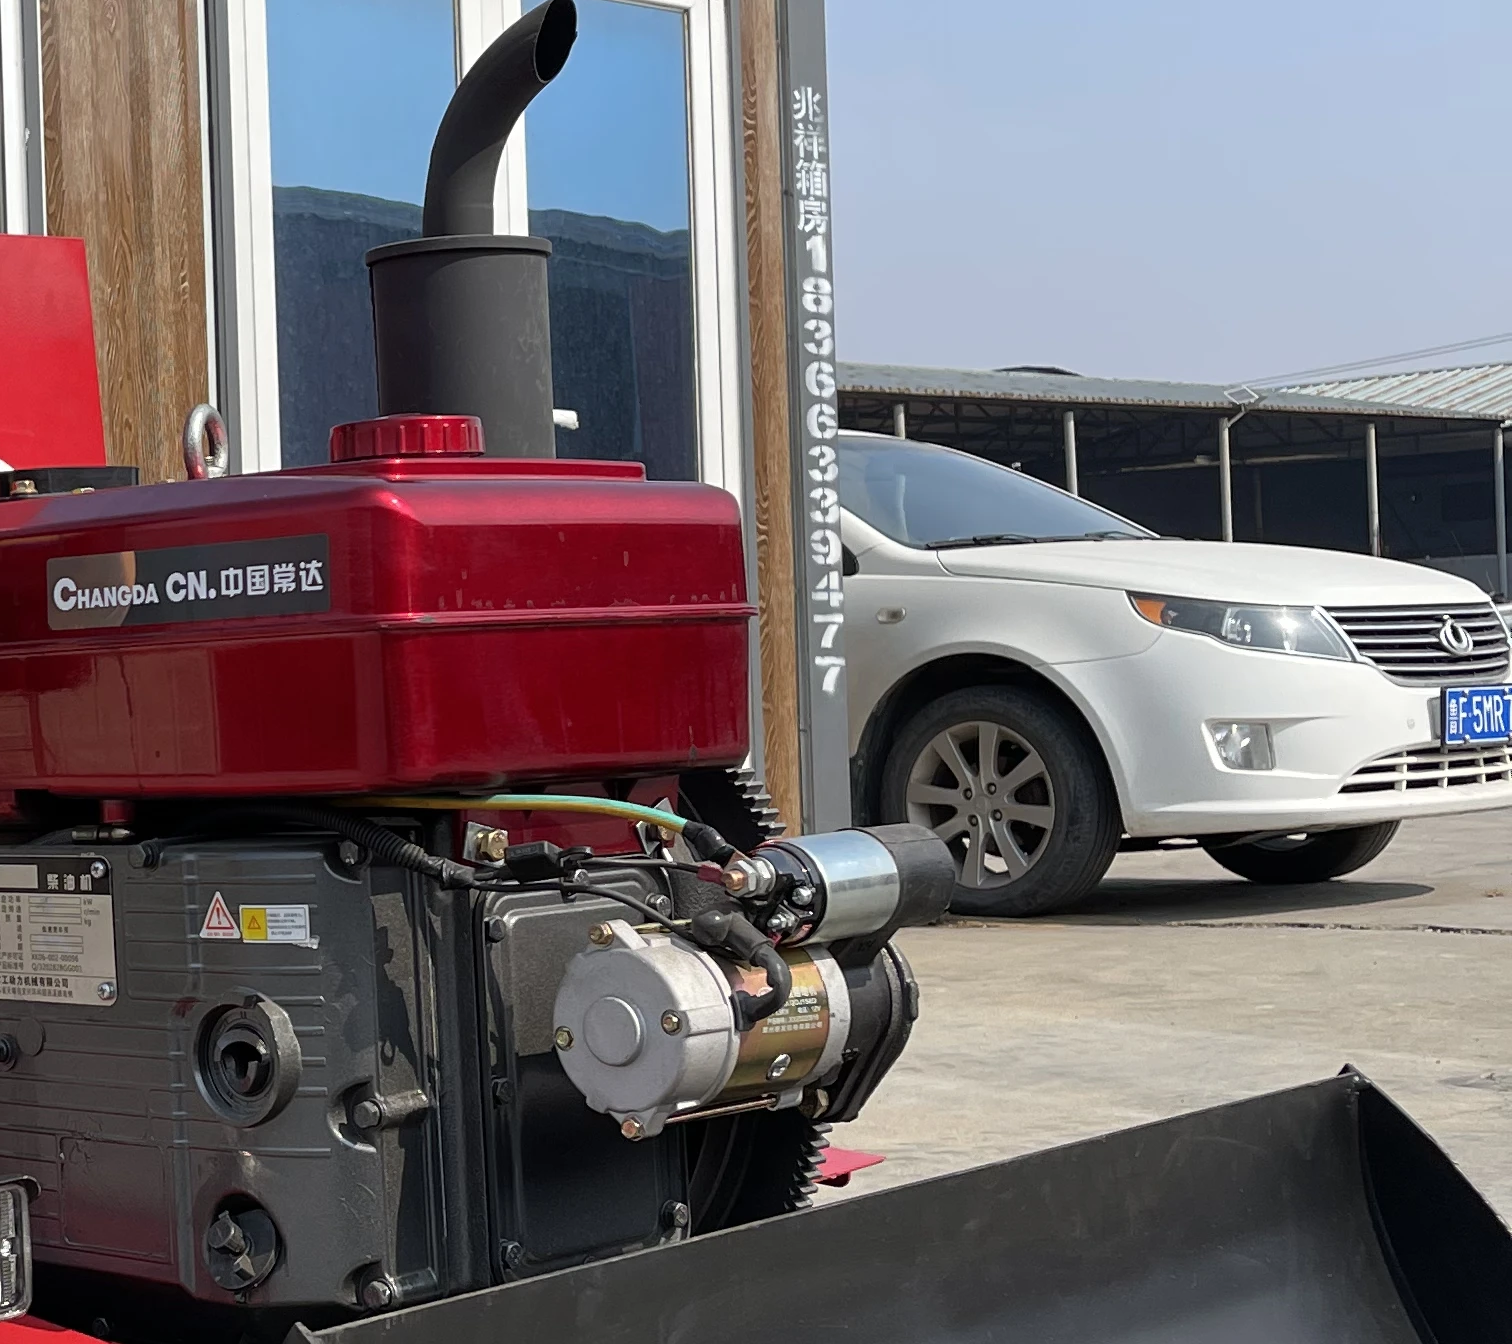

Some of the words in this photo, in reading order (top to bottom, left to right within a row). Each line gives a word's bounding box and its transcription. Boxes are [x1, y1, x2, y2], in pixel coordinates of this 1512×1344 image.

[53, 577, 159, 611] CHANGDA
[220, 560, 324, 598] 中国常达
[801, 235, 847, 696] 18366339477
